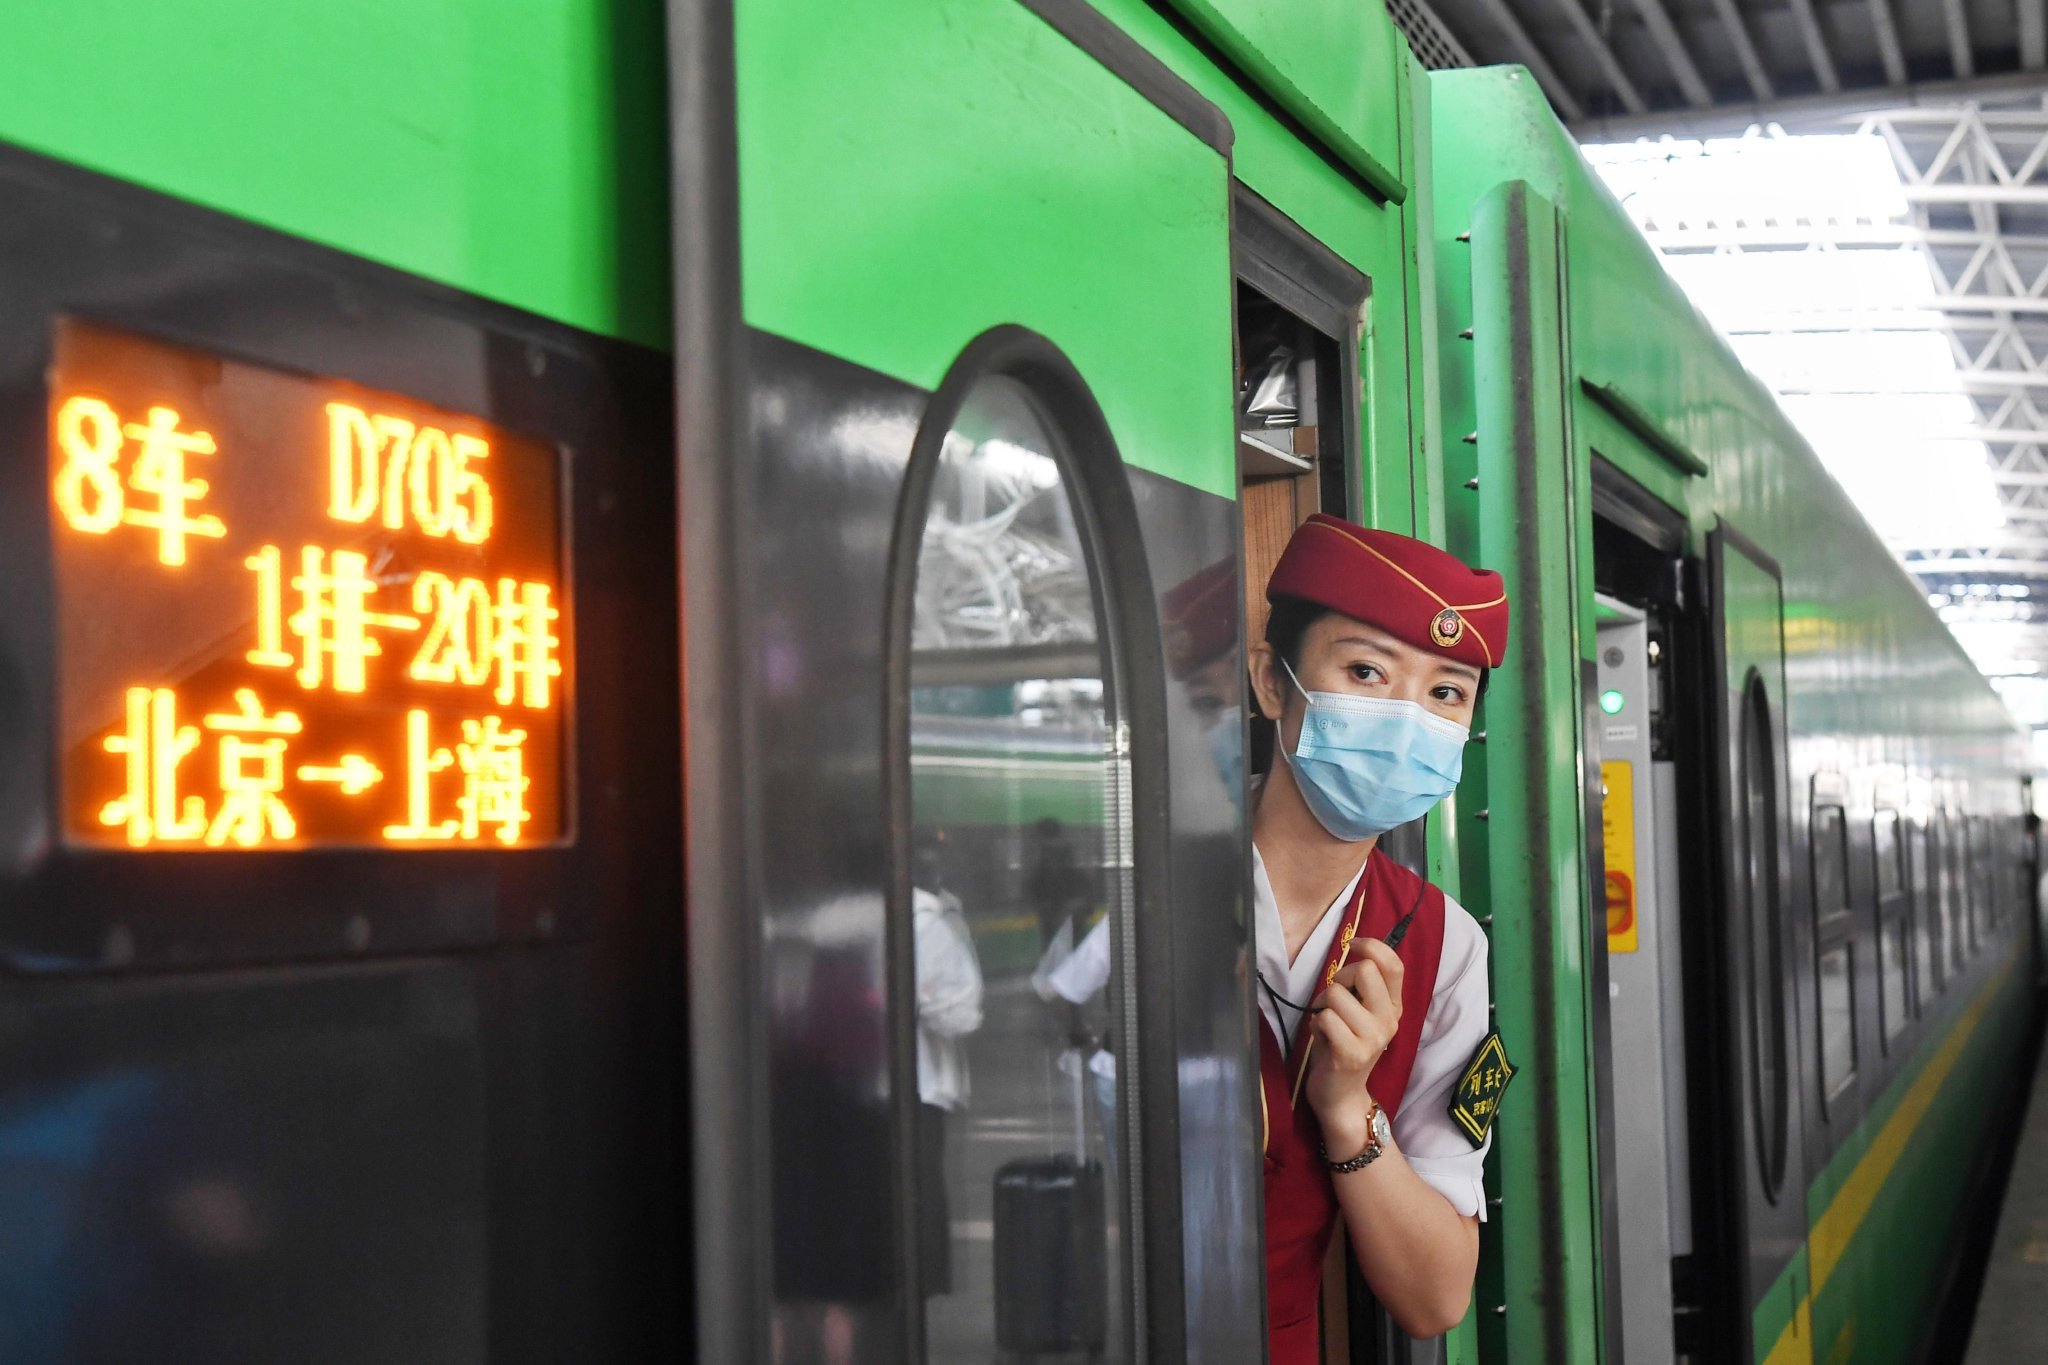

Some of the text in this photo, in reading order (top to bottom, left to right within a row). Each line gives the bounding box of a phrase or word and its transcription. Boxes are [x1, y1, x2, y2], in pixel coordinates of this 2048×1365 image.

[55, 397, 493, 567] 8车 D705
[99, 687, 530, 847] 北京 上海
